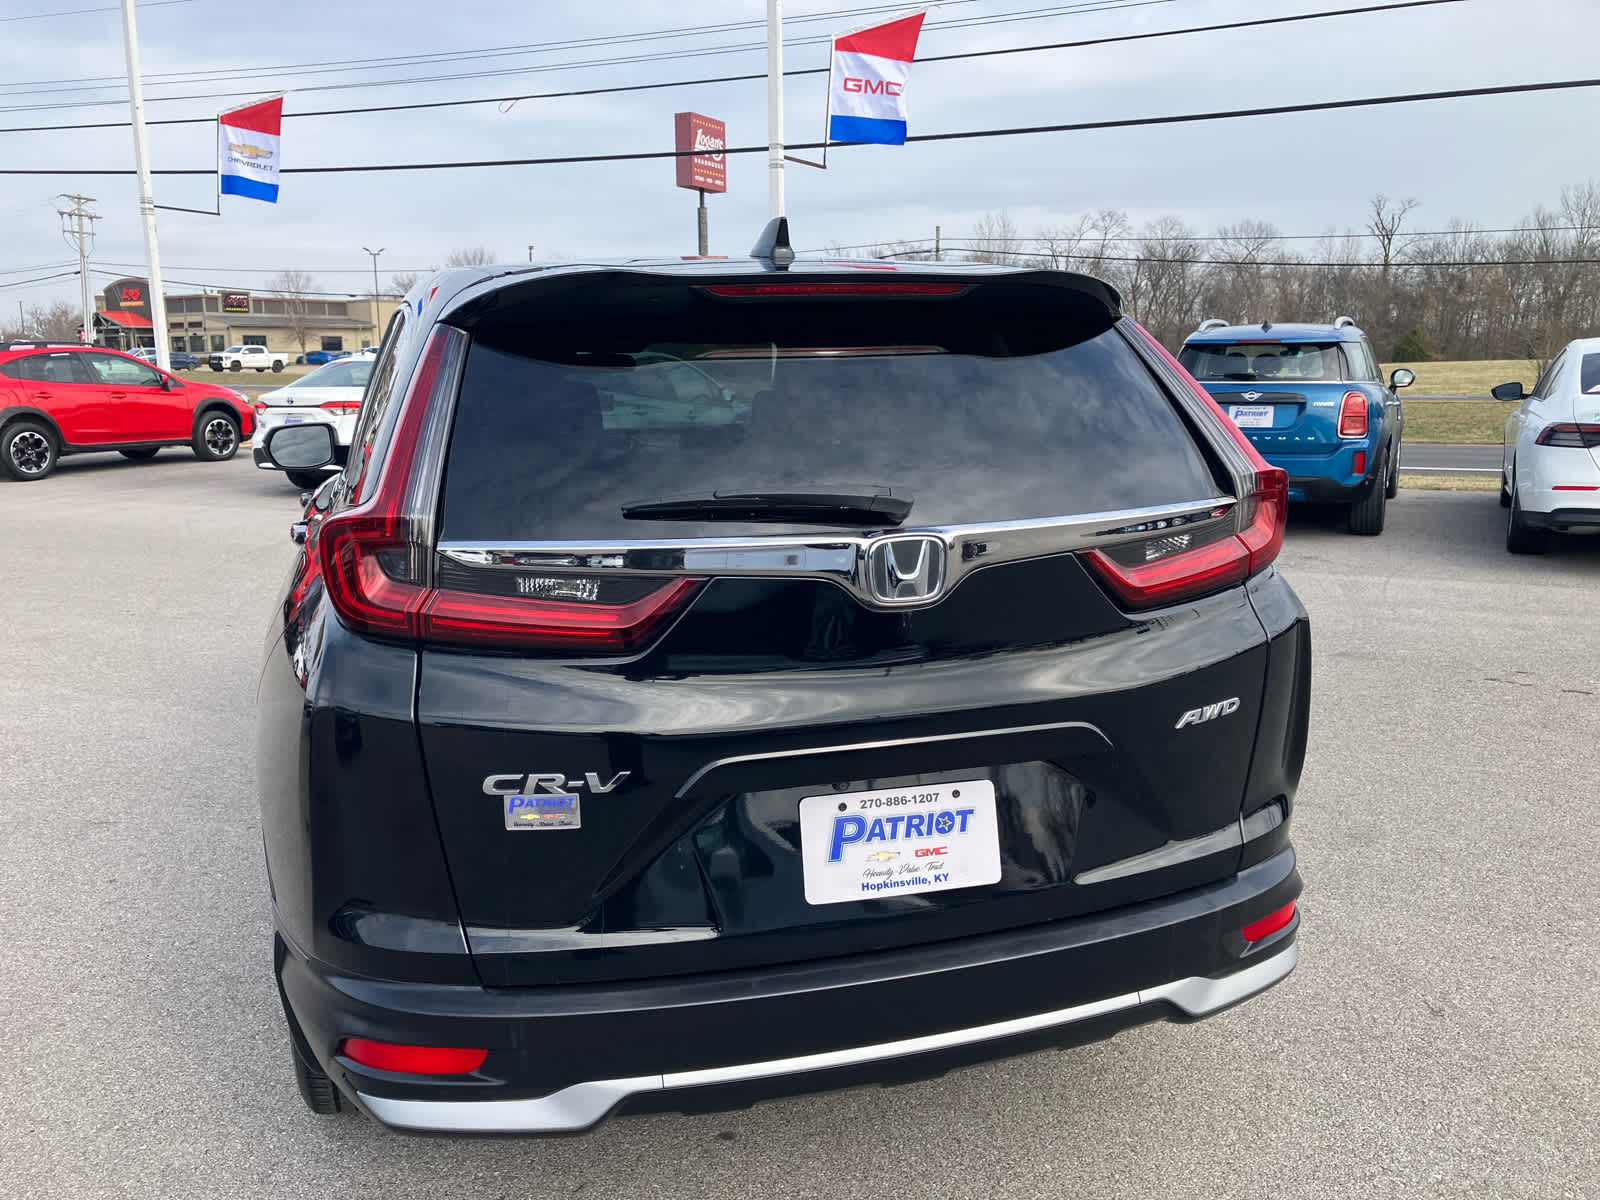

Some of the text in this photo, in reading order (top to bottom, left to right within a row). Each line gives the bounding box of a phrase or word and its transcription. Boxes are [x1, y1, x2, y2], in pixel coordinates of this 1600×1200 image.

[843, 77, 902, 97] GMC
[1175, 697, 1240, 729] AWD
[482, 771, 631, 796] CR-V
[508, 796, 576, 814] PATRIOT
[860, 793, 940, 809] 270-886-1207
[827, 809, 975, 863] PATRIOT
[914, 846, 948, 858] GMC
[861, 873, 949, 892] Hopkinsville, KY
